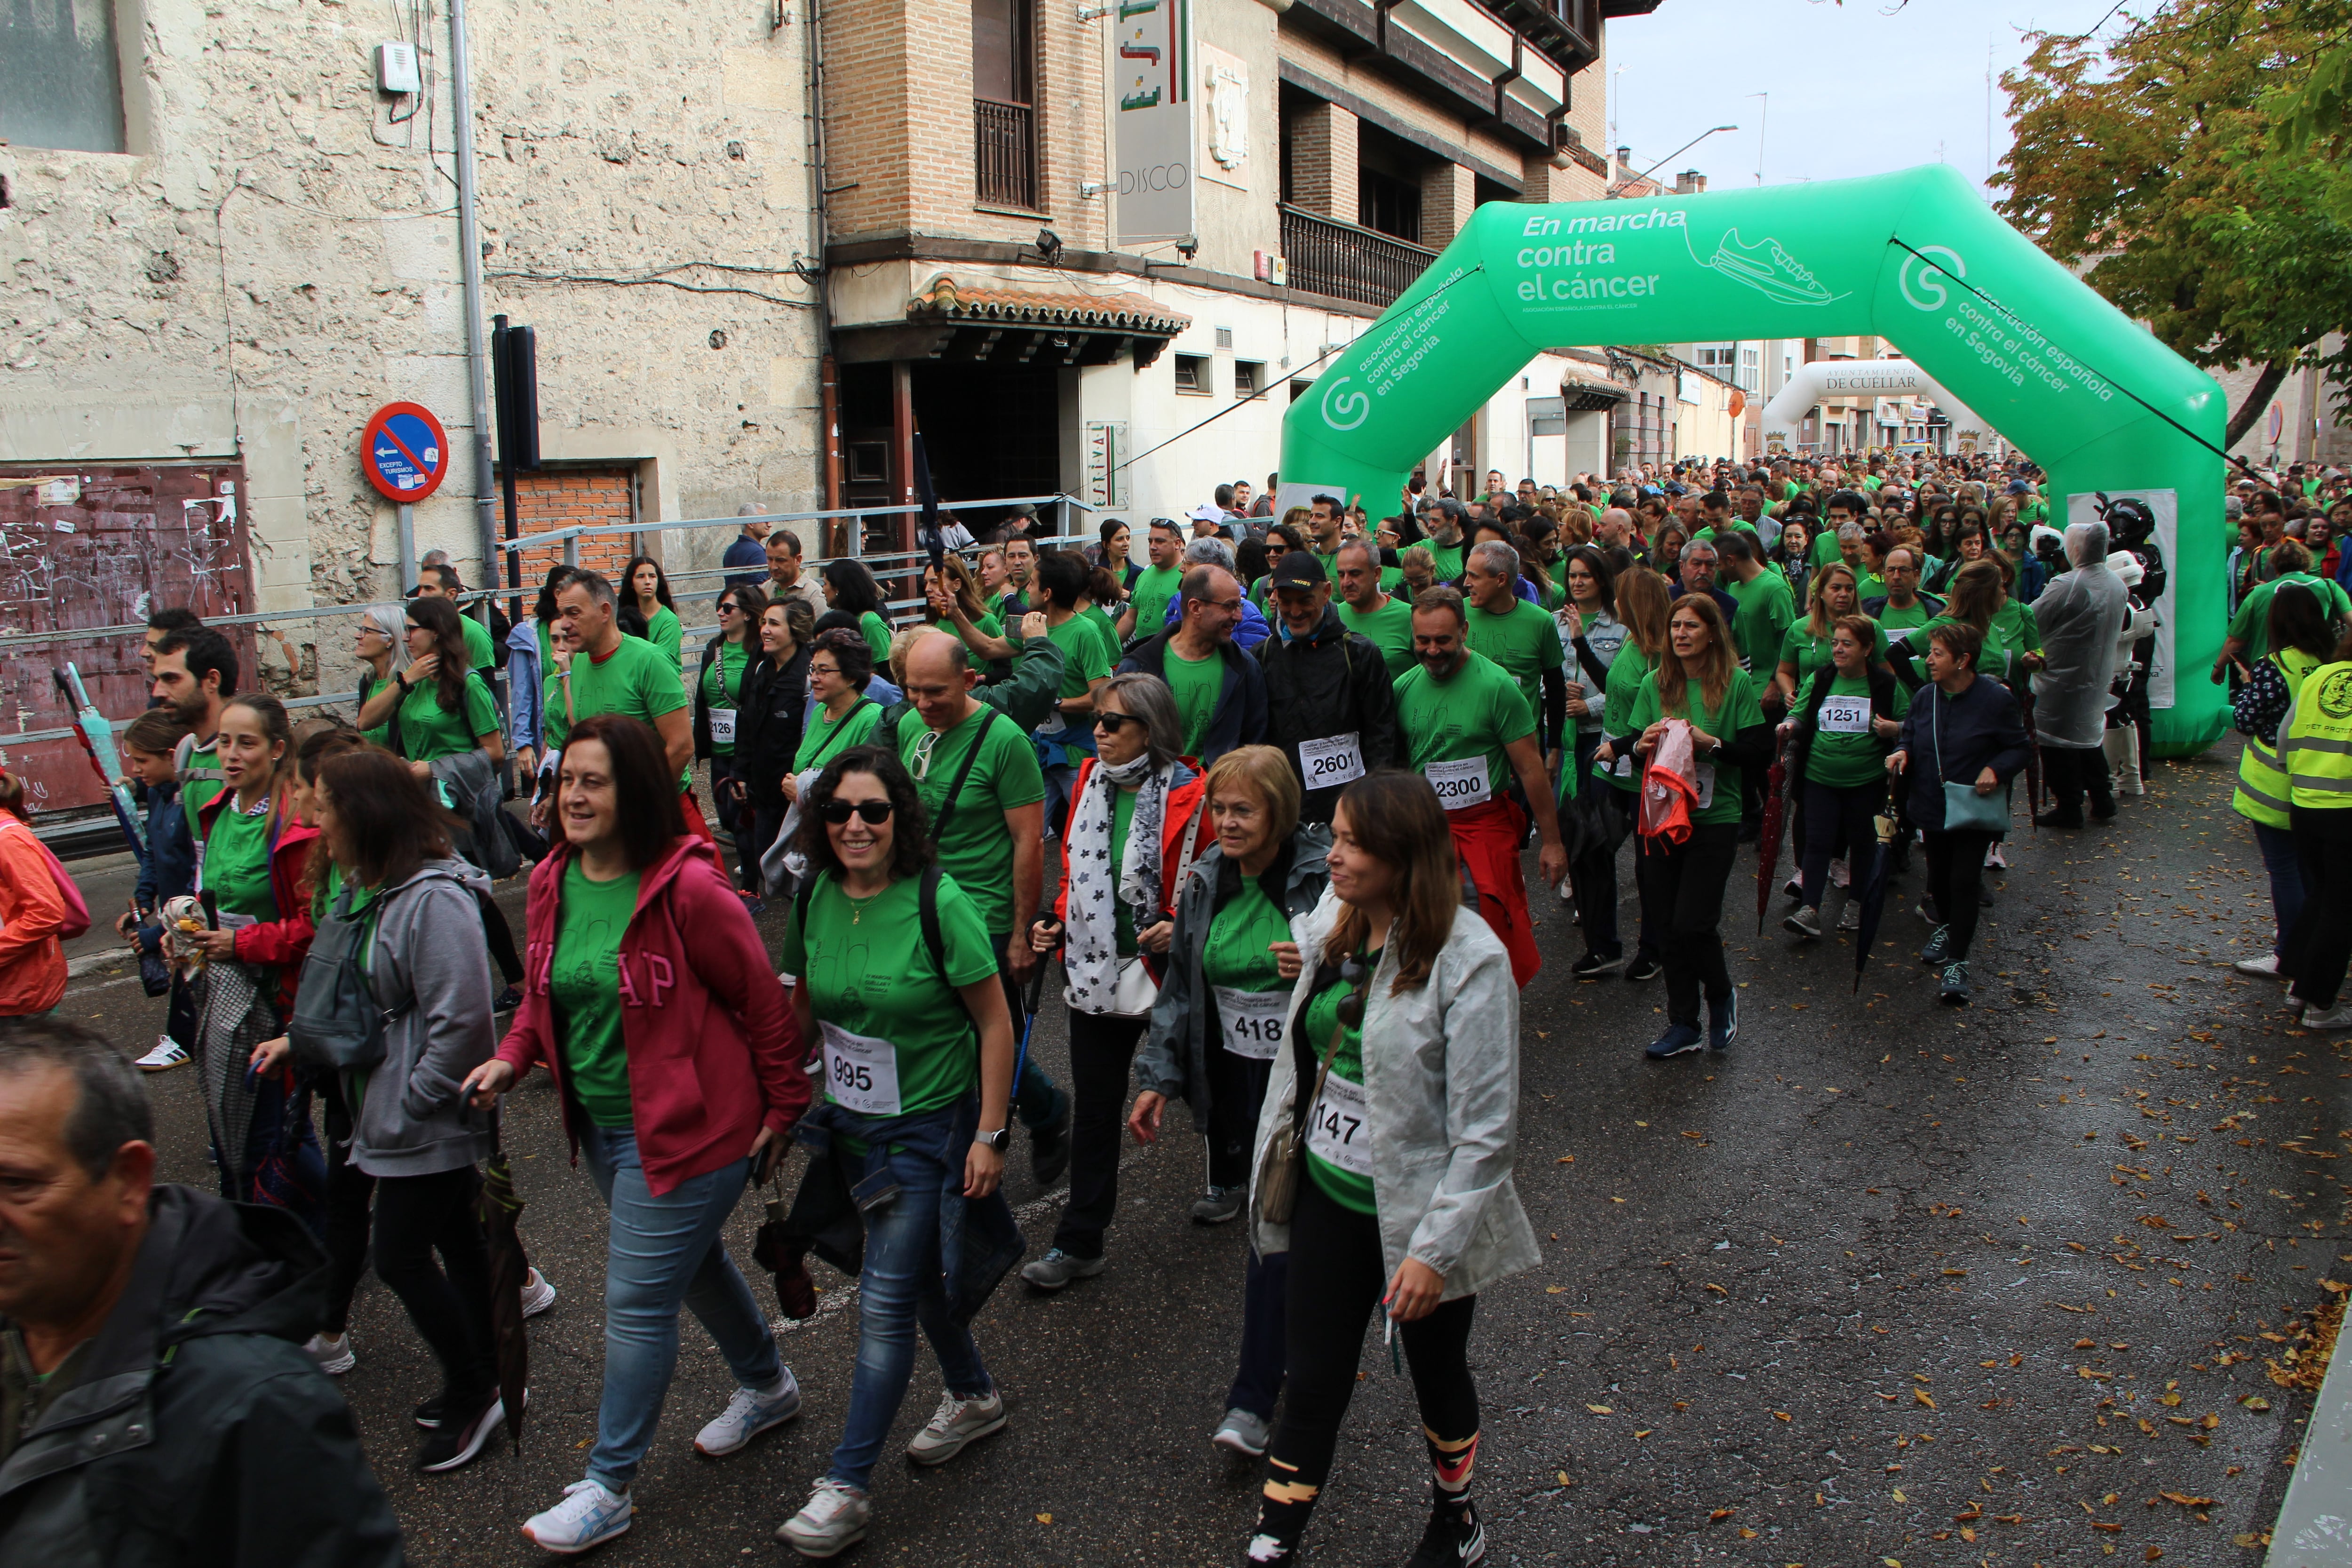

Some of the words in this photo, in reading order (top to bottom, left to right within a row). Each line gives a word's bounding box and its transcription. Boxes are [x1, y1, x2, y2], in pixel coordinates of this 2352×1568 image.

[1120, 163, 1187, 195] DISCO
[1523, 216, 1558, 237] En
[1567, 207, 1686, 235] marcha
[1517, 240, 1615, 268] contra
[1517, 274, 1547, 301] el
[1552, 272, 1660, 300] cáncer
[1359, 316, 1414, 372] asociación
[1414, 266, 1463, 318] española
[1367, 347, 1402, 384] contra
[1401, 335, 1413, 350] el
[1413, 299, 1451, 339] cáncer
[1945, 317, 1966, 338] en
[1965, 332, 2025, 387] Segovia
[1958, 301, 2004, 342] contra
[2003, 338, 2023, 355] el
[2018, 350, 2070, 394] cáncer
[1973, 287, 2047, 349] asociación
[2046, 344, 2114, 402] española
[1376, 379, 1394, 396] en
[1391, 335, 1440, 381] Segovia
[1827, 379, 1847, 389] DE
[1850, 376, 1917, 389] CUÉLLAR
[1826, 709, 1860, 722] 1251
[1313, 751, 1354, 775] 2601
[1436, 777, 1480, 797] 2300
[1235, 1016, 1282, 1041] 418
[834, 1055, 873, 1091] 995
[1318, 1103, 1361, 1145] 147
